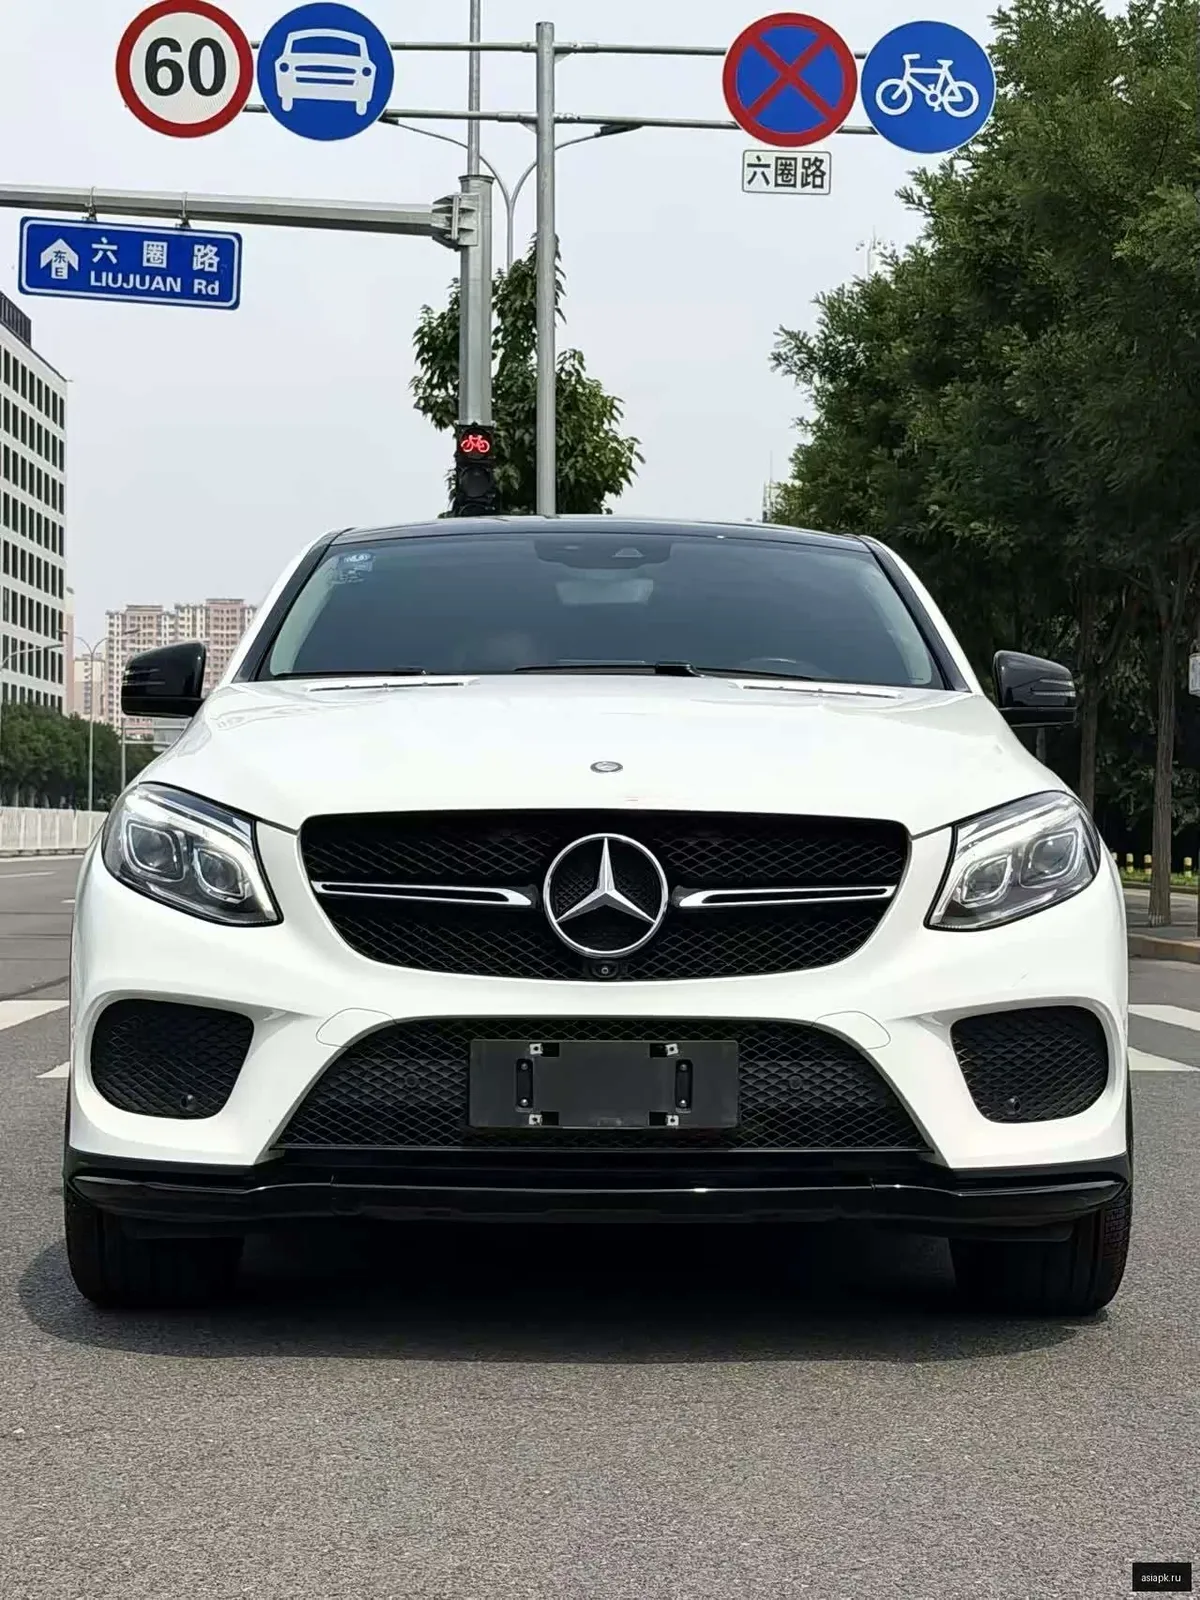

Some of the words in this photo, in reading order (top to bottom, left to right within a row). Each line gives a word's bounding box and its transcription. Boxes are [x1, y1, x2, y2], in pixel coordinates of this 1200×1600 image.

[145, 37, 226, 96] 60
[747, 155, 826, 188] 六圈路
[53, 250, 67, 264] 东
[55, 267, 63, 277] E
[90, 271, 181, 292] LIUJUAN
[193, 279, 219, 295] Rd
